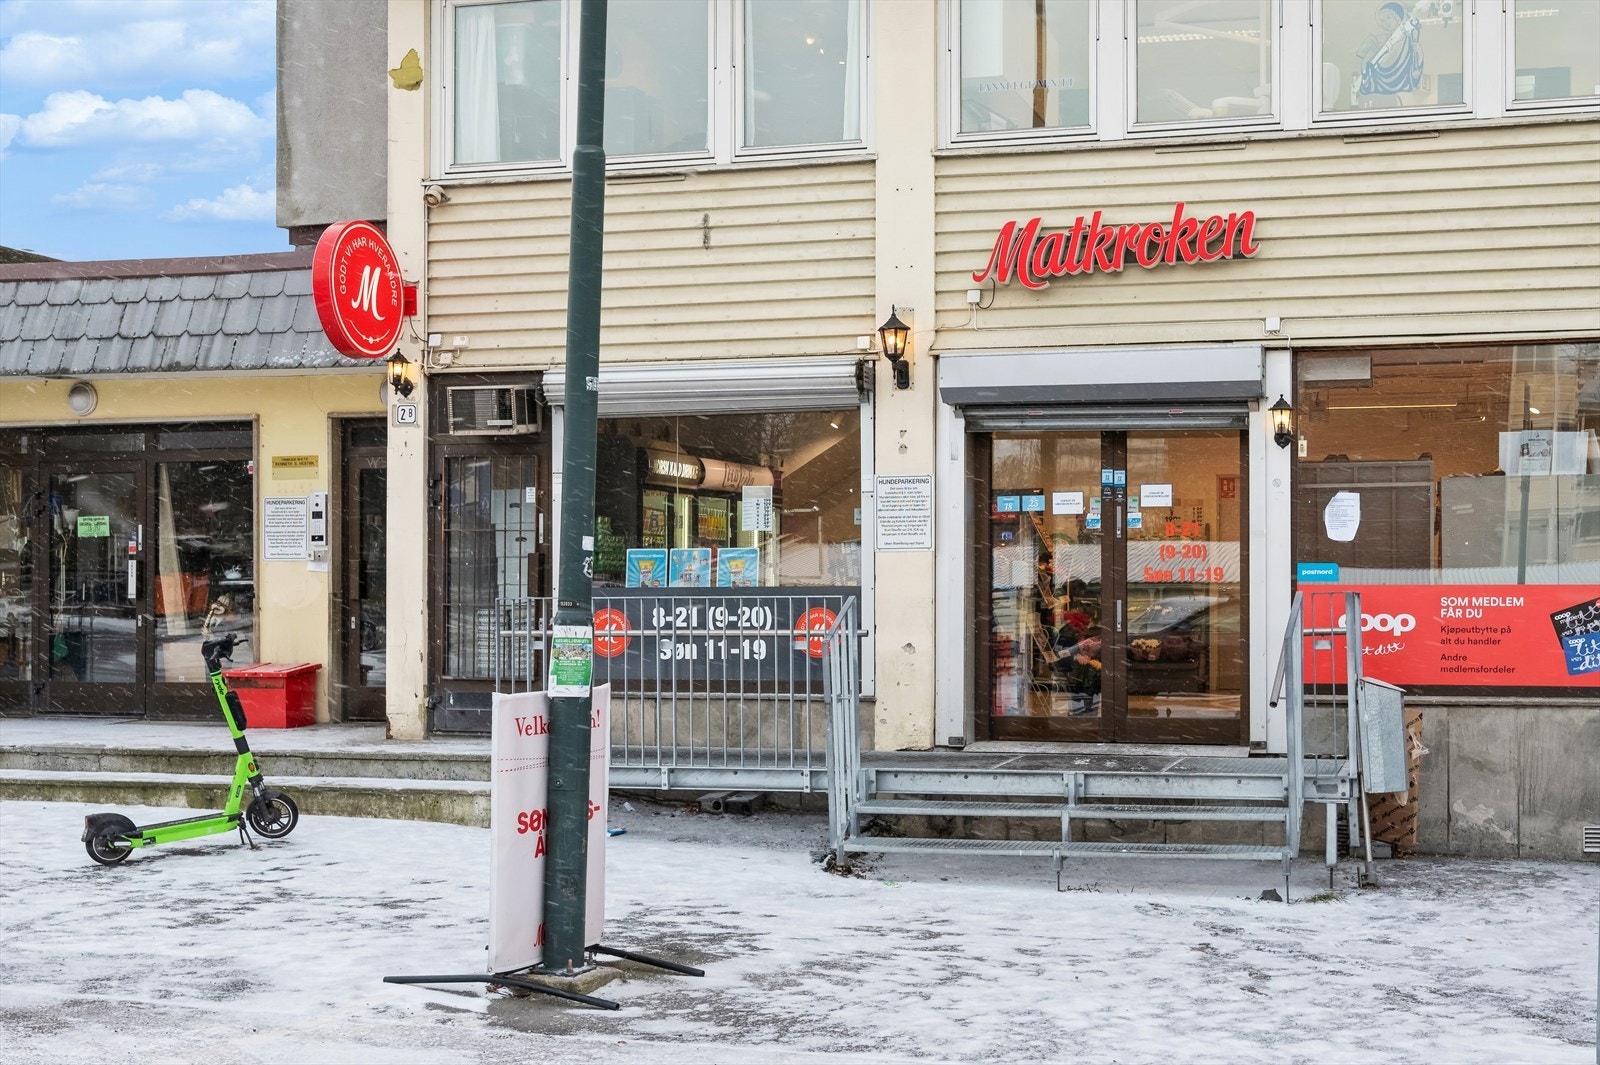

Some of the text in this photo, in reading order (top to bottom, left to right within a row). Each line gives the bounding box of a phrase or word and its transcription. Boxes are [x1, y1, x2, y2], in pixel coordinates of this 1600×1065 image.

[972, 201, 1261, 290] Matkroken
[339, 236, 398, 307] GODT VI HAR HVERANDRE
[351, 265, 386, 321] M
[400, 408, 414, 421] 2 B
[878, 477, 930, 485] HUNDEPARKERING
[1158, 544, 1208, 562] (9-20)
[1143, 566, 1224, 582] Søn 11-19
[1301, 568, 1333, 576] postnord
[1440, 596, 1524, 607] SOM MEDLEM
[652, 606, 699, 628] 8-21
[708, 606, 773, 631] (9-20)
[1440, 606, 1483, 619] FÅR DU
[1440, 625, 1512, 636] Kjøpeutbytte på
[660, 638, 767, 660] Søn 11-19
[1440, 637, 1502, 646] alt du handler
[1440, 653, 1468, 662] Andre
[1440, 664, 1516, 674] medlemsfordeler
[214, 678, 225, 696] ryde
[514, 709, 600, 737] Velkn!
[517, 799, 601, 835] SØS-
